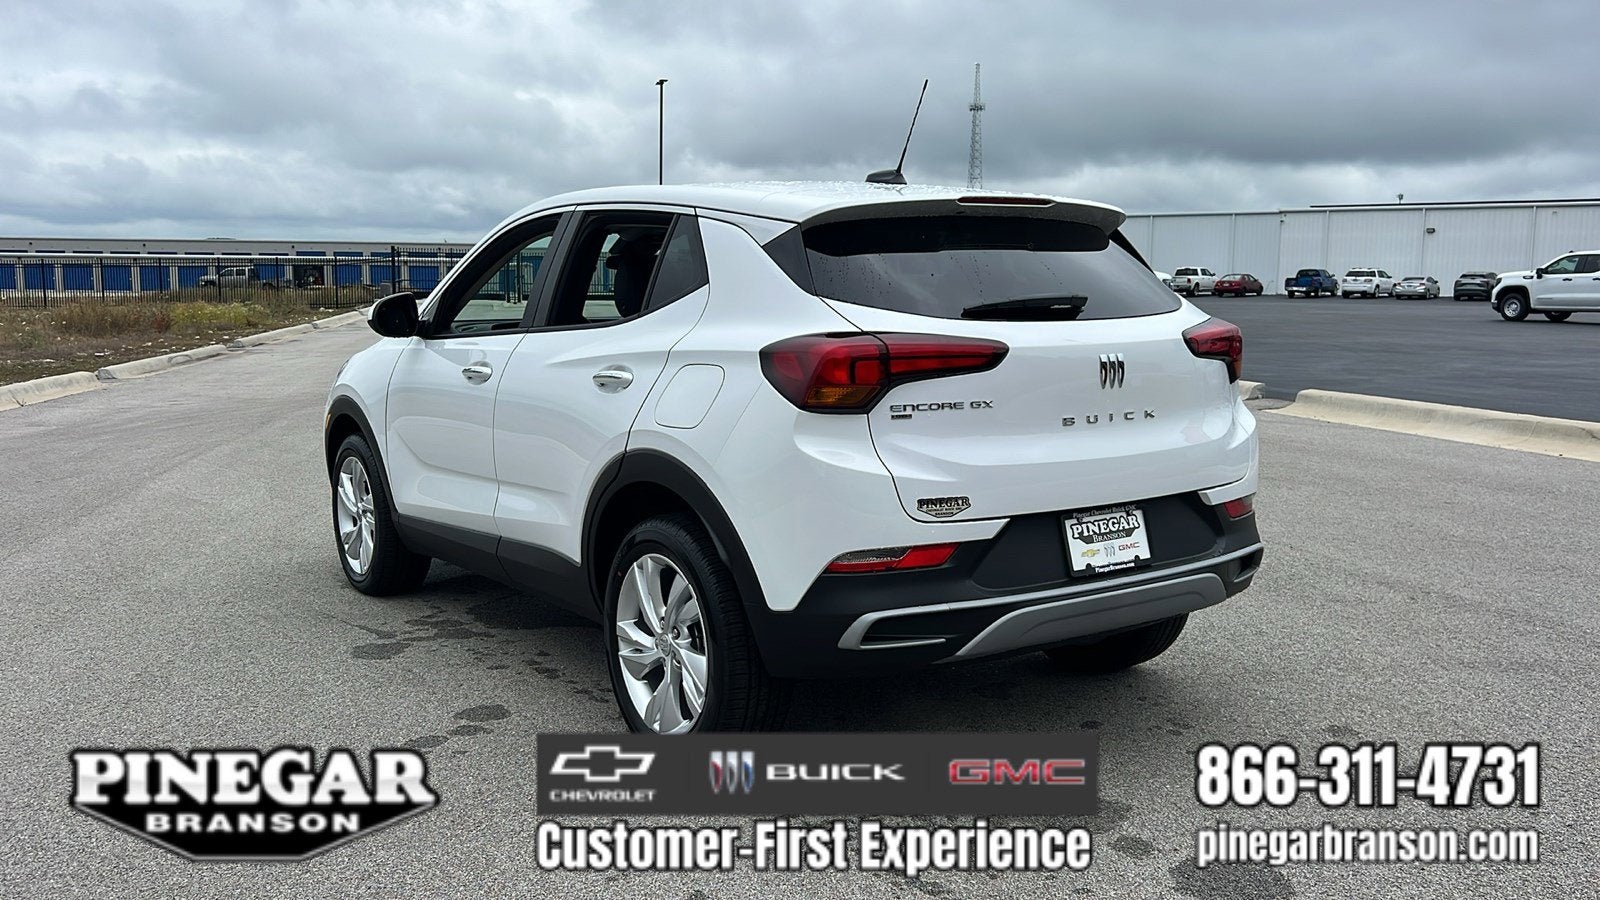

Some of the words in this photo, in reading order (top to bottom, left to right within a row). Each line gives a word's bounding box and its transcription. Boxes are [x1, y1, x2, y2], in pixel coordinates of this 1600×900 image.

[889, 401, 965, 413] ENCORE
[970, 400, 994, 410] GX
[1062, 410, 1155, 427] BUICK
[918, 498, 969, 509] PINEGAR
[1071, 515, 1140, 538] PINEGAR
[1118, 541, 1140, 551] GMC
